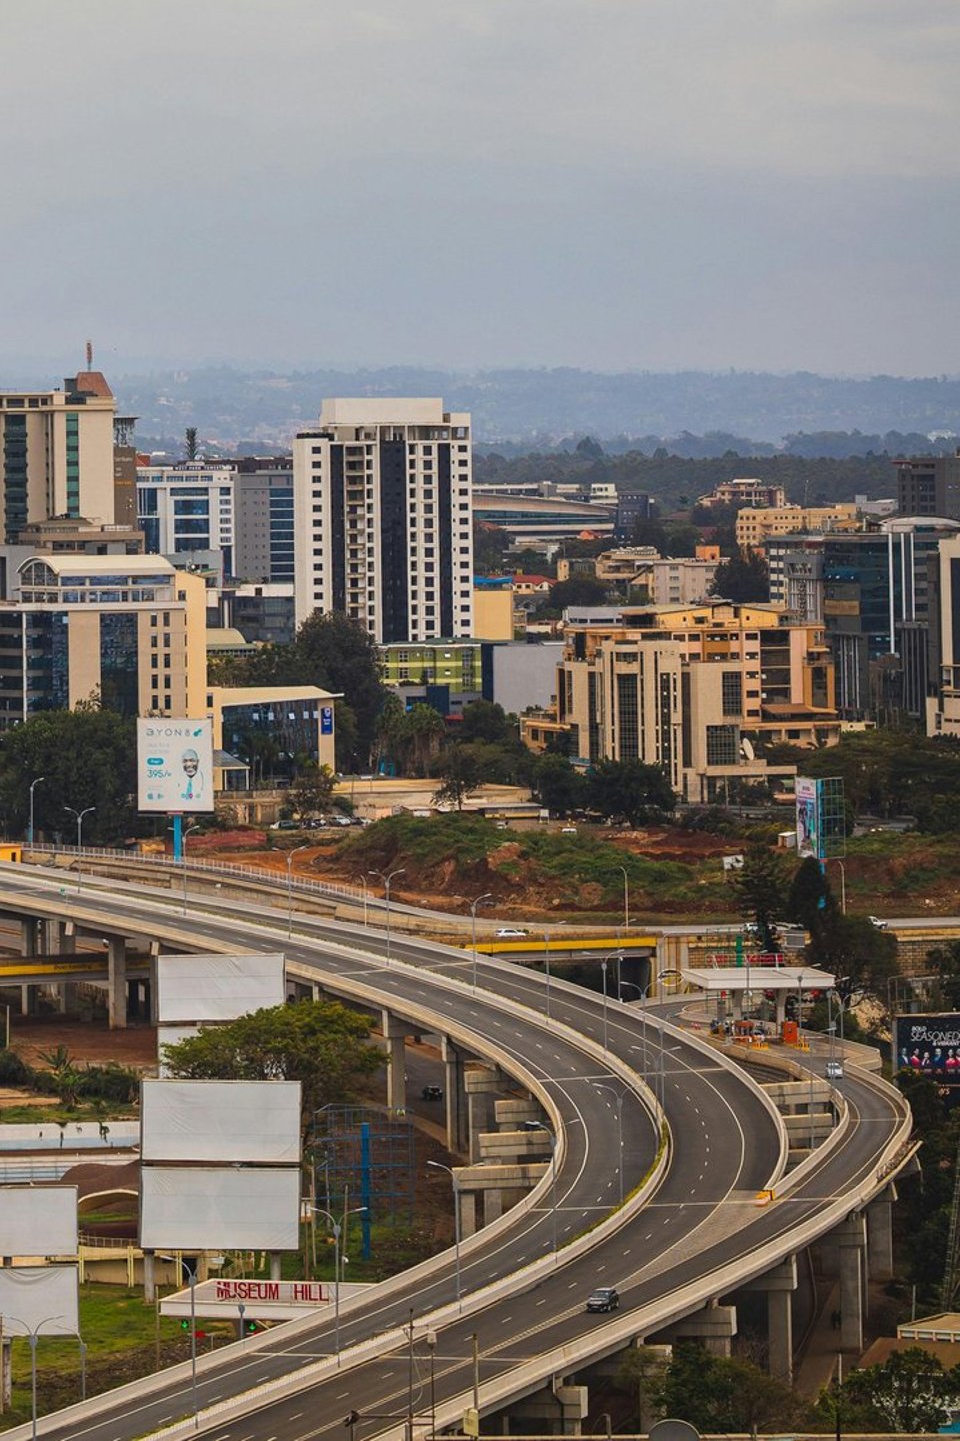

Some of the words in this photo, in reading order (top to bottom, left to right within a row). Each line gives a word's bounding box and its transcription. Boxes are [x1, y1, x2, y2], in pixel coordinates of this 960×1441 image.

[911, 1030, 960, 1041] SEASONED
[216, 1281, 279, 1301] MUSEUM
[294, 1283, 330, 1301] HILL
